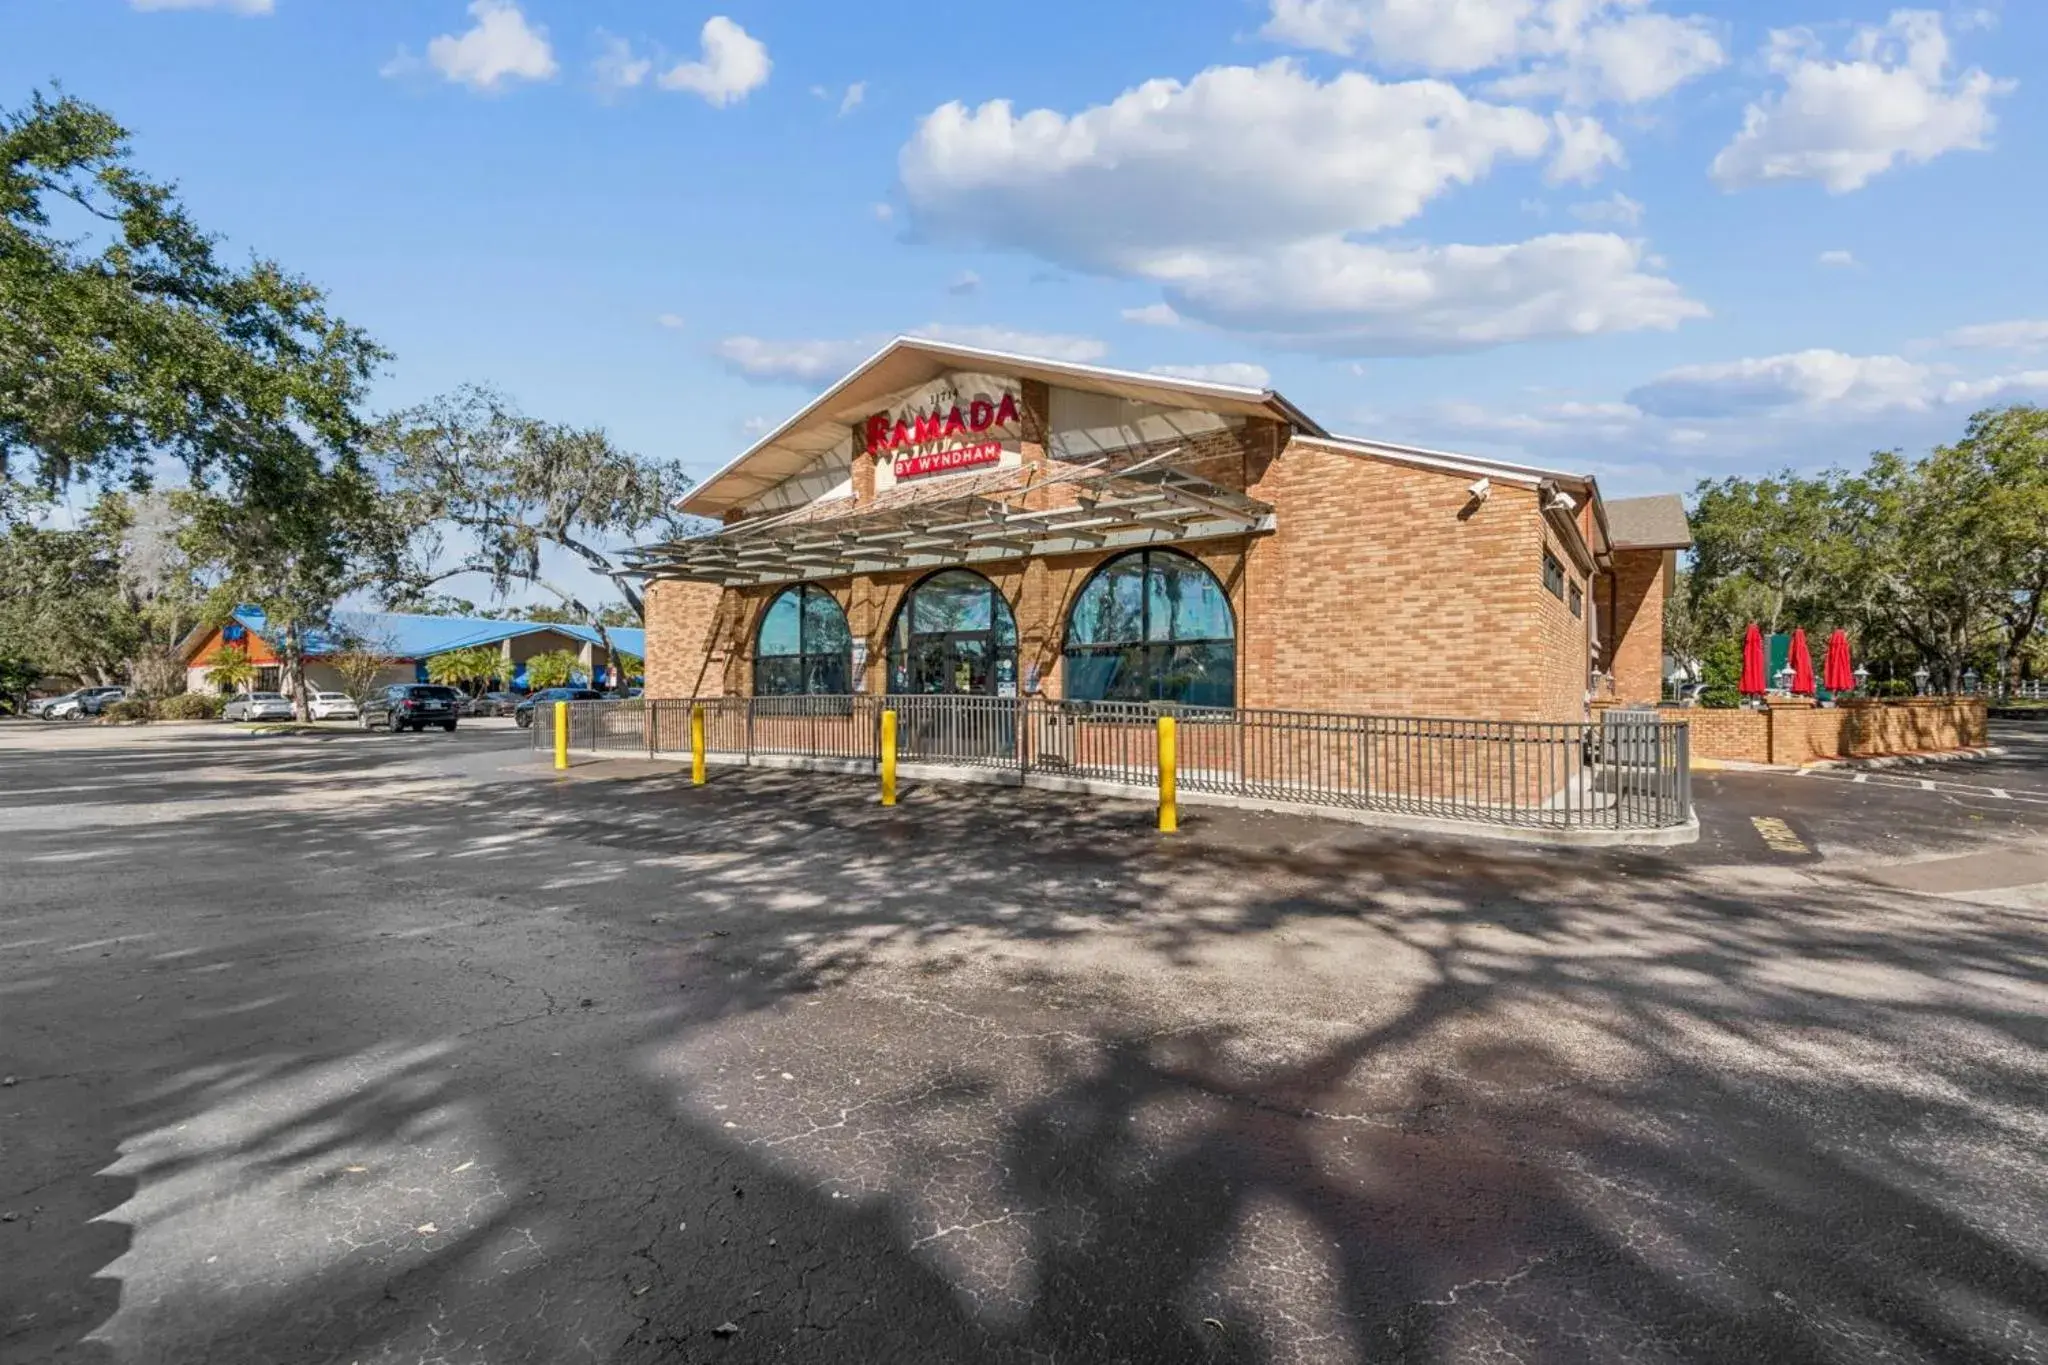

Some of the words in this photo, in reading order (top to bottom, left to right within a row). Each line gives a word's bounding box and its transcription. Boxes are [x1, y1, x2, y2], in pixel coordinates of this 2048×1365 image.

[867, 393, 1020, 456] RAMADA
[896, 459, 913, 474] BY
[919, 446, 996, 470] WYNDHAM
